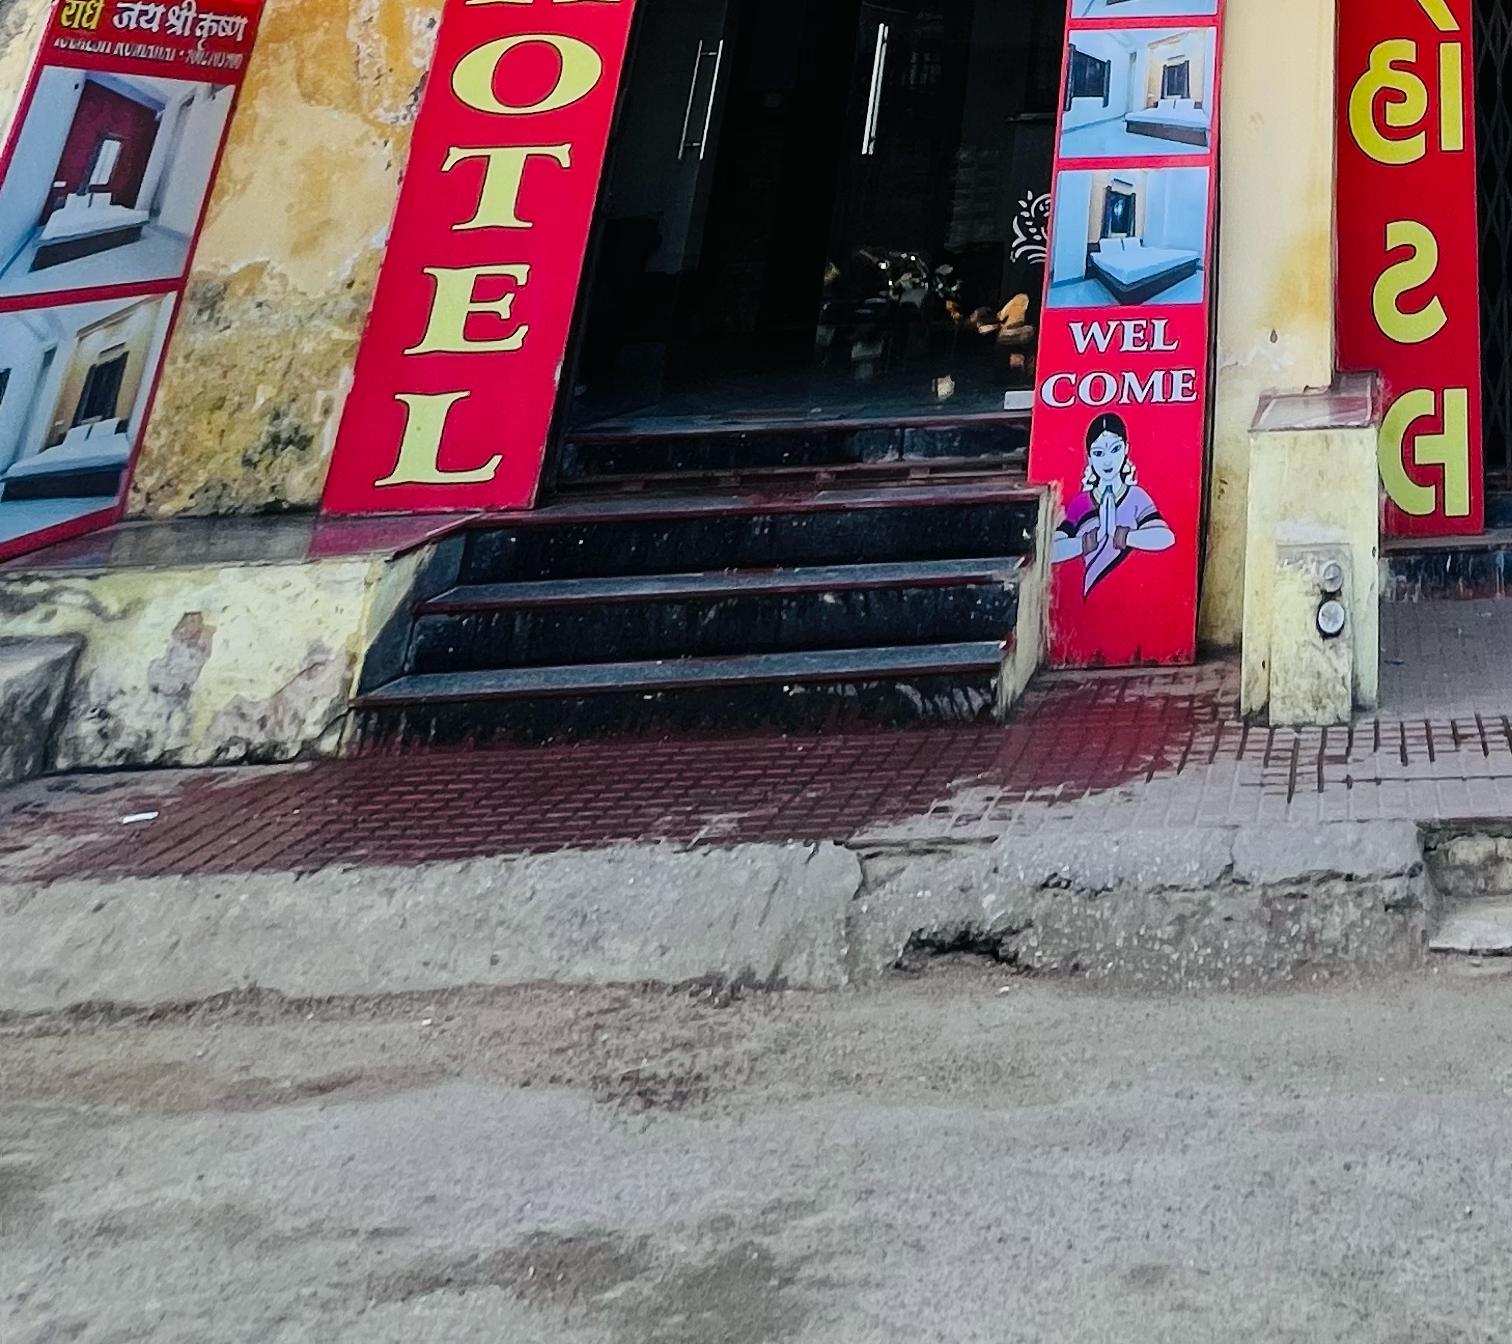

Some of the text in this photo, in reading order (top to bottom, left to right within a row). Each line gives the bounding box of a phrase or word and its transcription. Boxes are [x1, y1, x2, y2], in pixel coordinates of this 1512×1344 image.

[112, 0, 166, 33] जय
[195, 12, 248, 50] कृष्ण
[1068, 318, 1179, 354] WEL
[1040, 369, 1198, 407] COME
